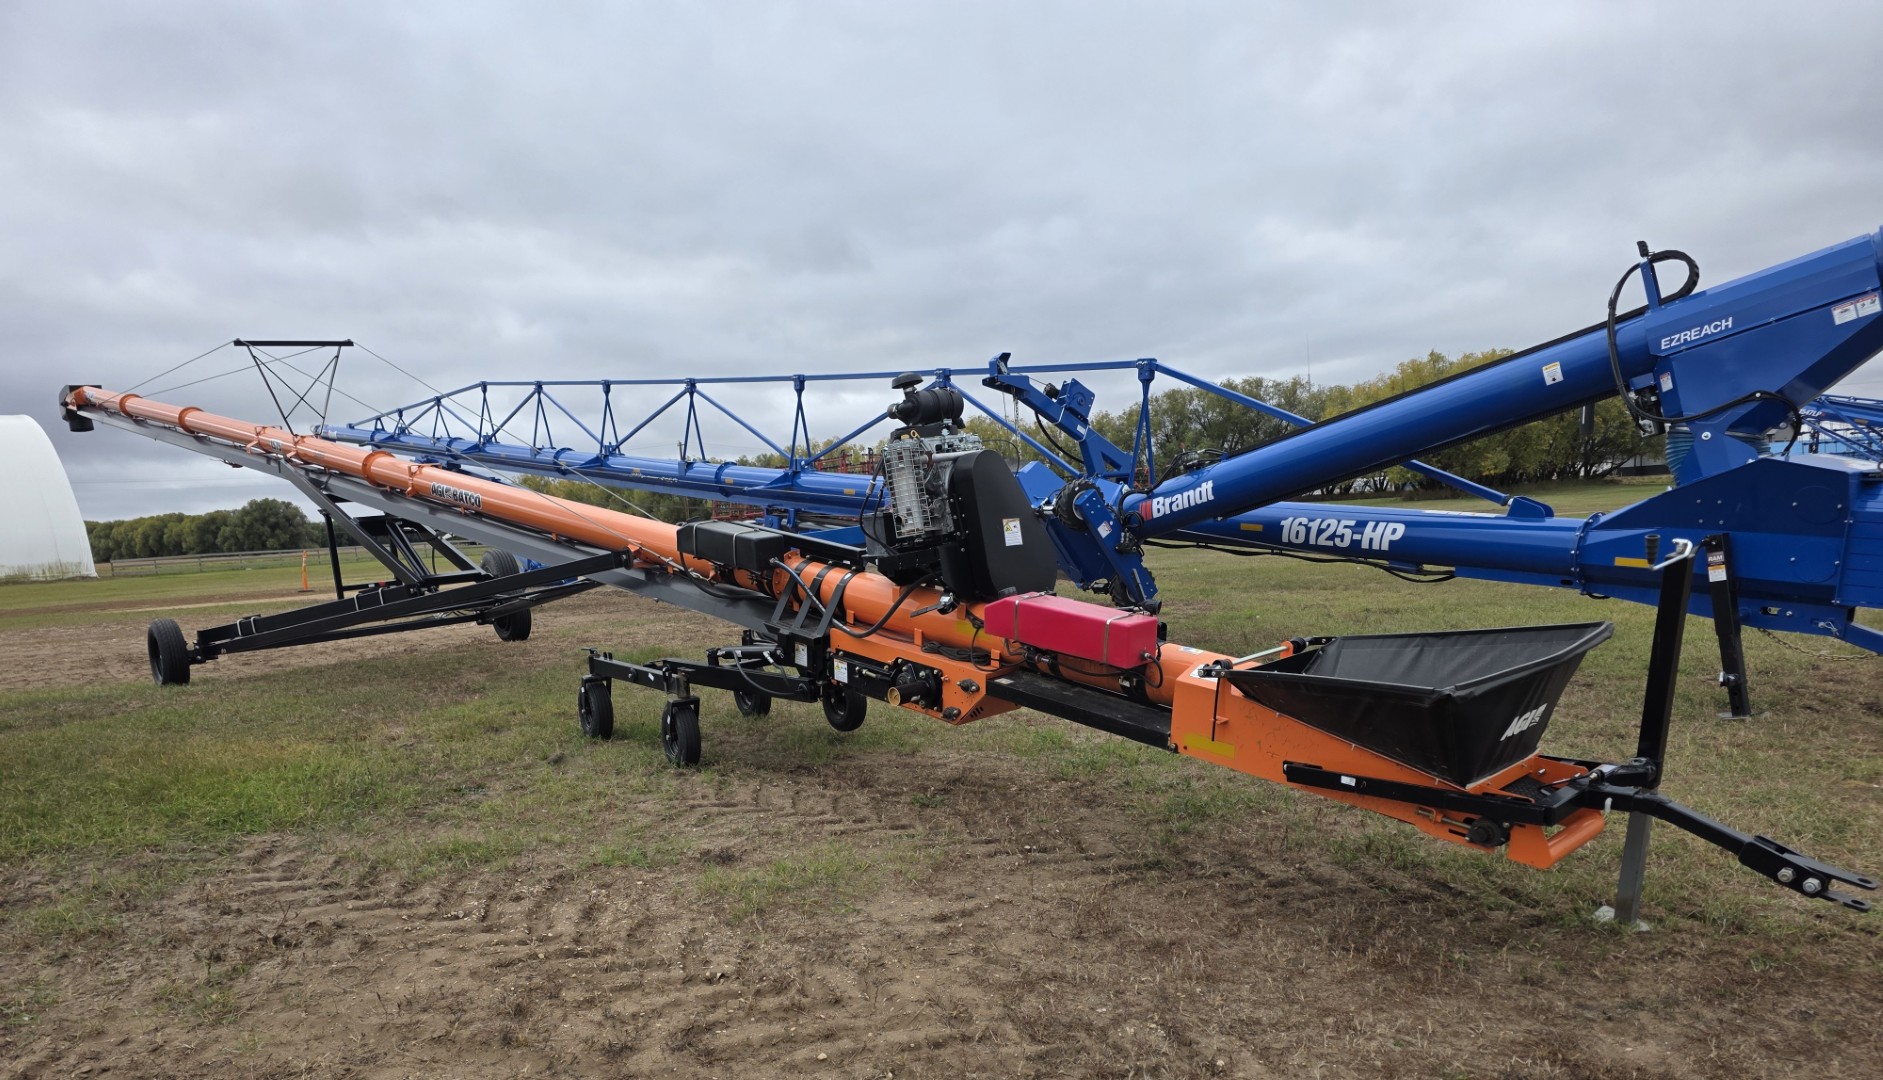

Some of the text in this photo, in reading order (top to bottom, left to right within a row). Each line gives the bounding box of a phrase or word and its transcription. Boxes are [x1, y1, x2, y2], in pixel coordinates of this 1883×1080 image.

[1661, 317, 1733, 350] EZREACH
[431, 482, 482, 509] AGI BATCO
[1152, 480, 1215, 518] Brandt
[1280, 517, 1406, 551] 16125-HP
[1500, 709, 1538, 741] AGI
